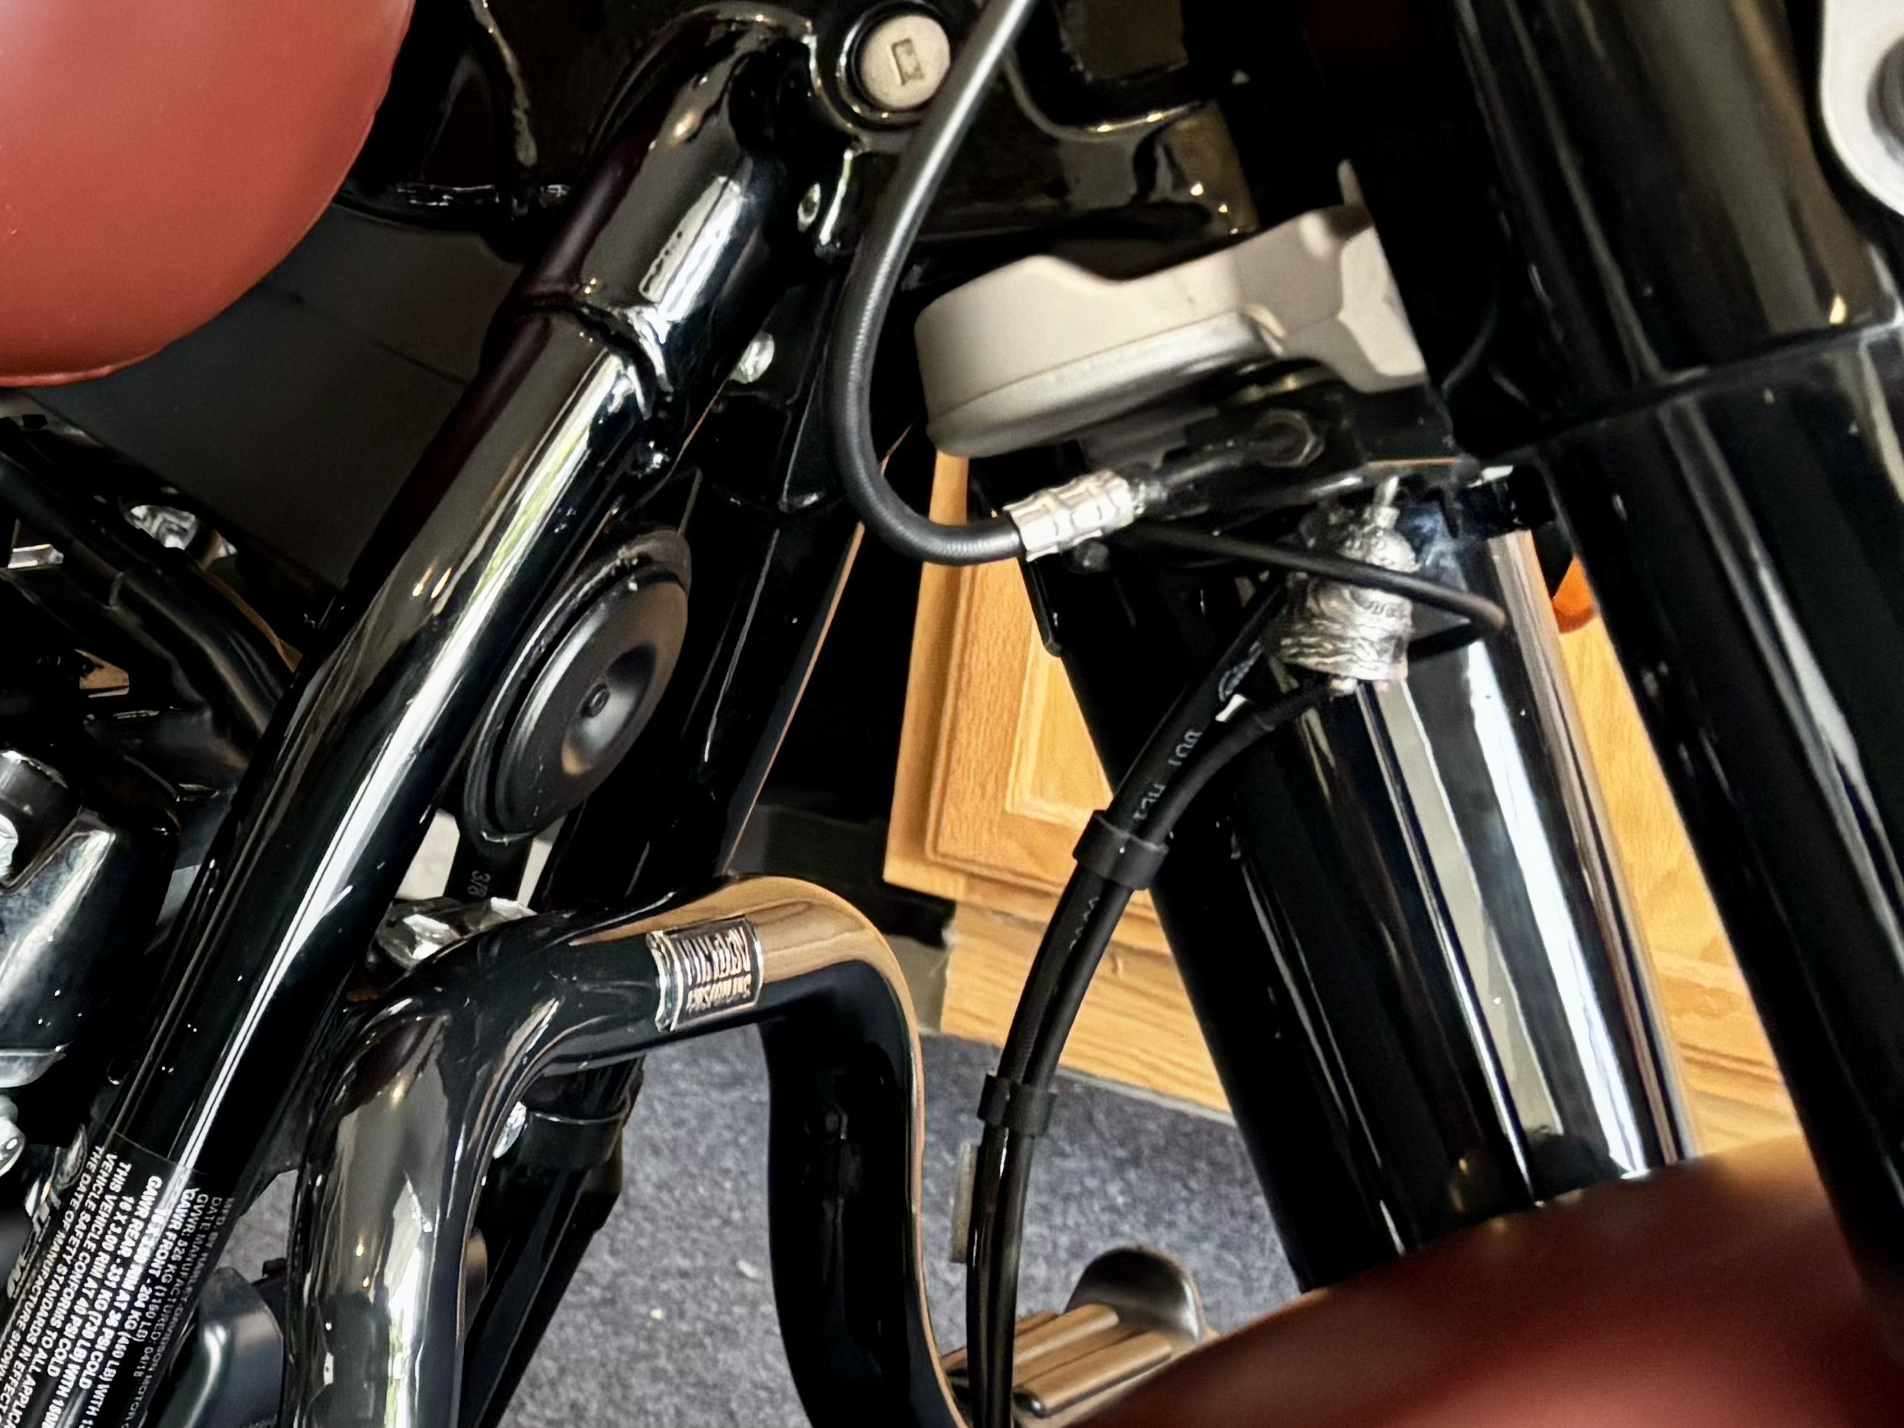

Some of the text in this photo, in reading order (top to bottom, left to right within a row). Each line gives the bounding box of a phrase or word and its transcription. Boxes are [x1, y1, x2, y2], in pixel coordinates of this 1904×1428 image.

[86, 1146, 105, 1173] THE
[70, 1173, 92, 1210] DATE
[85, 1154, 117, 1211] VEHICLE
[109, 1162, 132, 1193] THIS
[134, 1176, 162, 1219] GAWR
[168, 1189, 196, 1230] GAWR
[200, 1197, 223, 1230] DATE
[62, 1210, 75, 1232] OF
[83, 1194, 117, 1252] VEHICLE
[144, 1222, 161, 1239] X
[181, 1194, 209, 1236] GVWR:
[62, 1210, 91, 1264] SAFETY
[117, 1218, 144, 1257] REAR
[149, 1231, 177, 1277] FRONT
[16, 1230, 66, 1331] MANUFACTURE
[47, 1196, 135, 1377] 16 X 3.00 RIM AT 40 PSI COLD
[50, 1251, 91, 1328] CONFORMS
[104, 1264, 123, 1288] 331
[120, 1262, 143, 1293] RIM
[161, 1264, 177, 1283] KG
[26, 1264, 68, 1345] STANDARDS
[94, 1289, 113, 1311] KG
[111, 1287, 132, 1313] AT
[124, 1309, 142, 1330] KG
[132, 1321, 151, 1342] LB)
[18, 1344, 33, 1361] IN
[41, 1329, 58, 1349] TO
[69, 1339, 91, 1363] LB)
[93, 1325, 115, 1354] PSI
[28, 1347, 48, 1373] ALL
[76, 1347, 105, 1392] COLD
[100, 1360, 120, 1381] LB)
[56, 1363, 81, 1398] WITH
[86, 1384, 110, 1416] WITH
[125, 1375, 152, 1420] MOTOR
